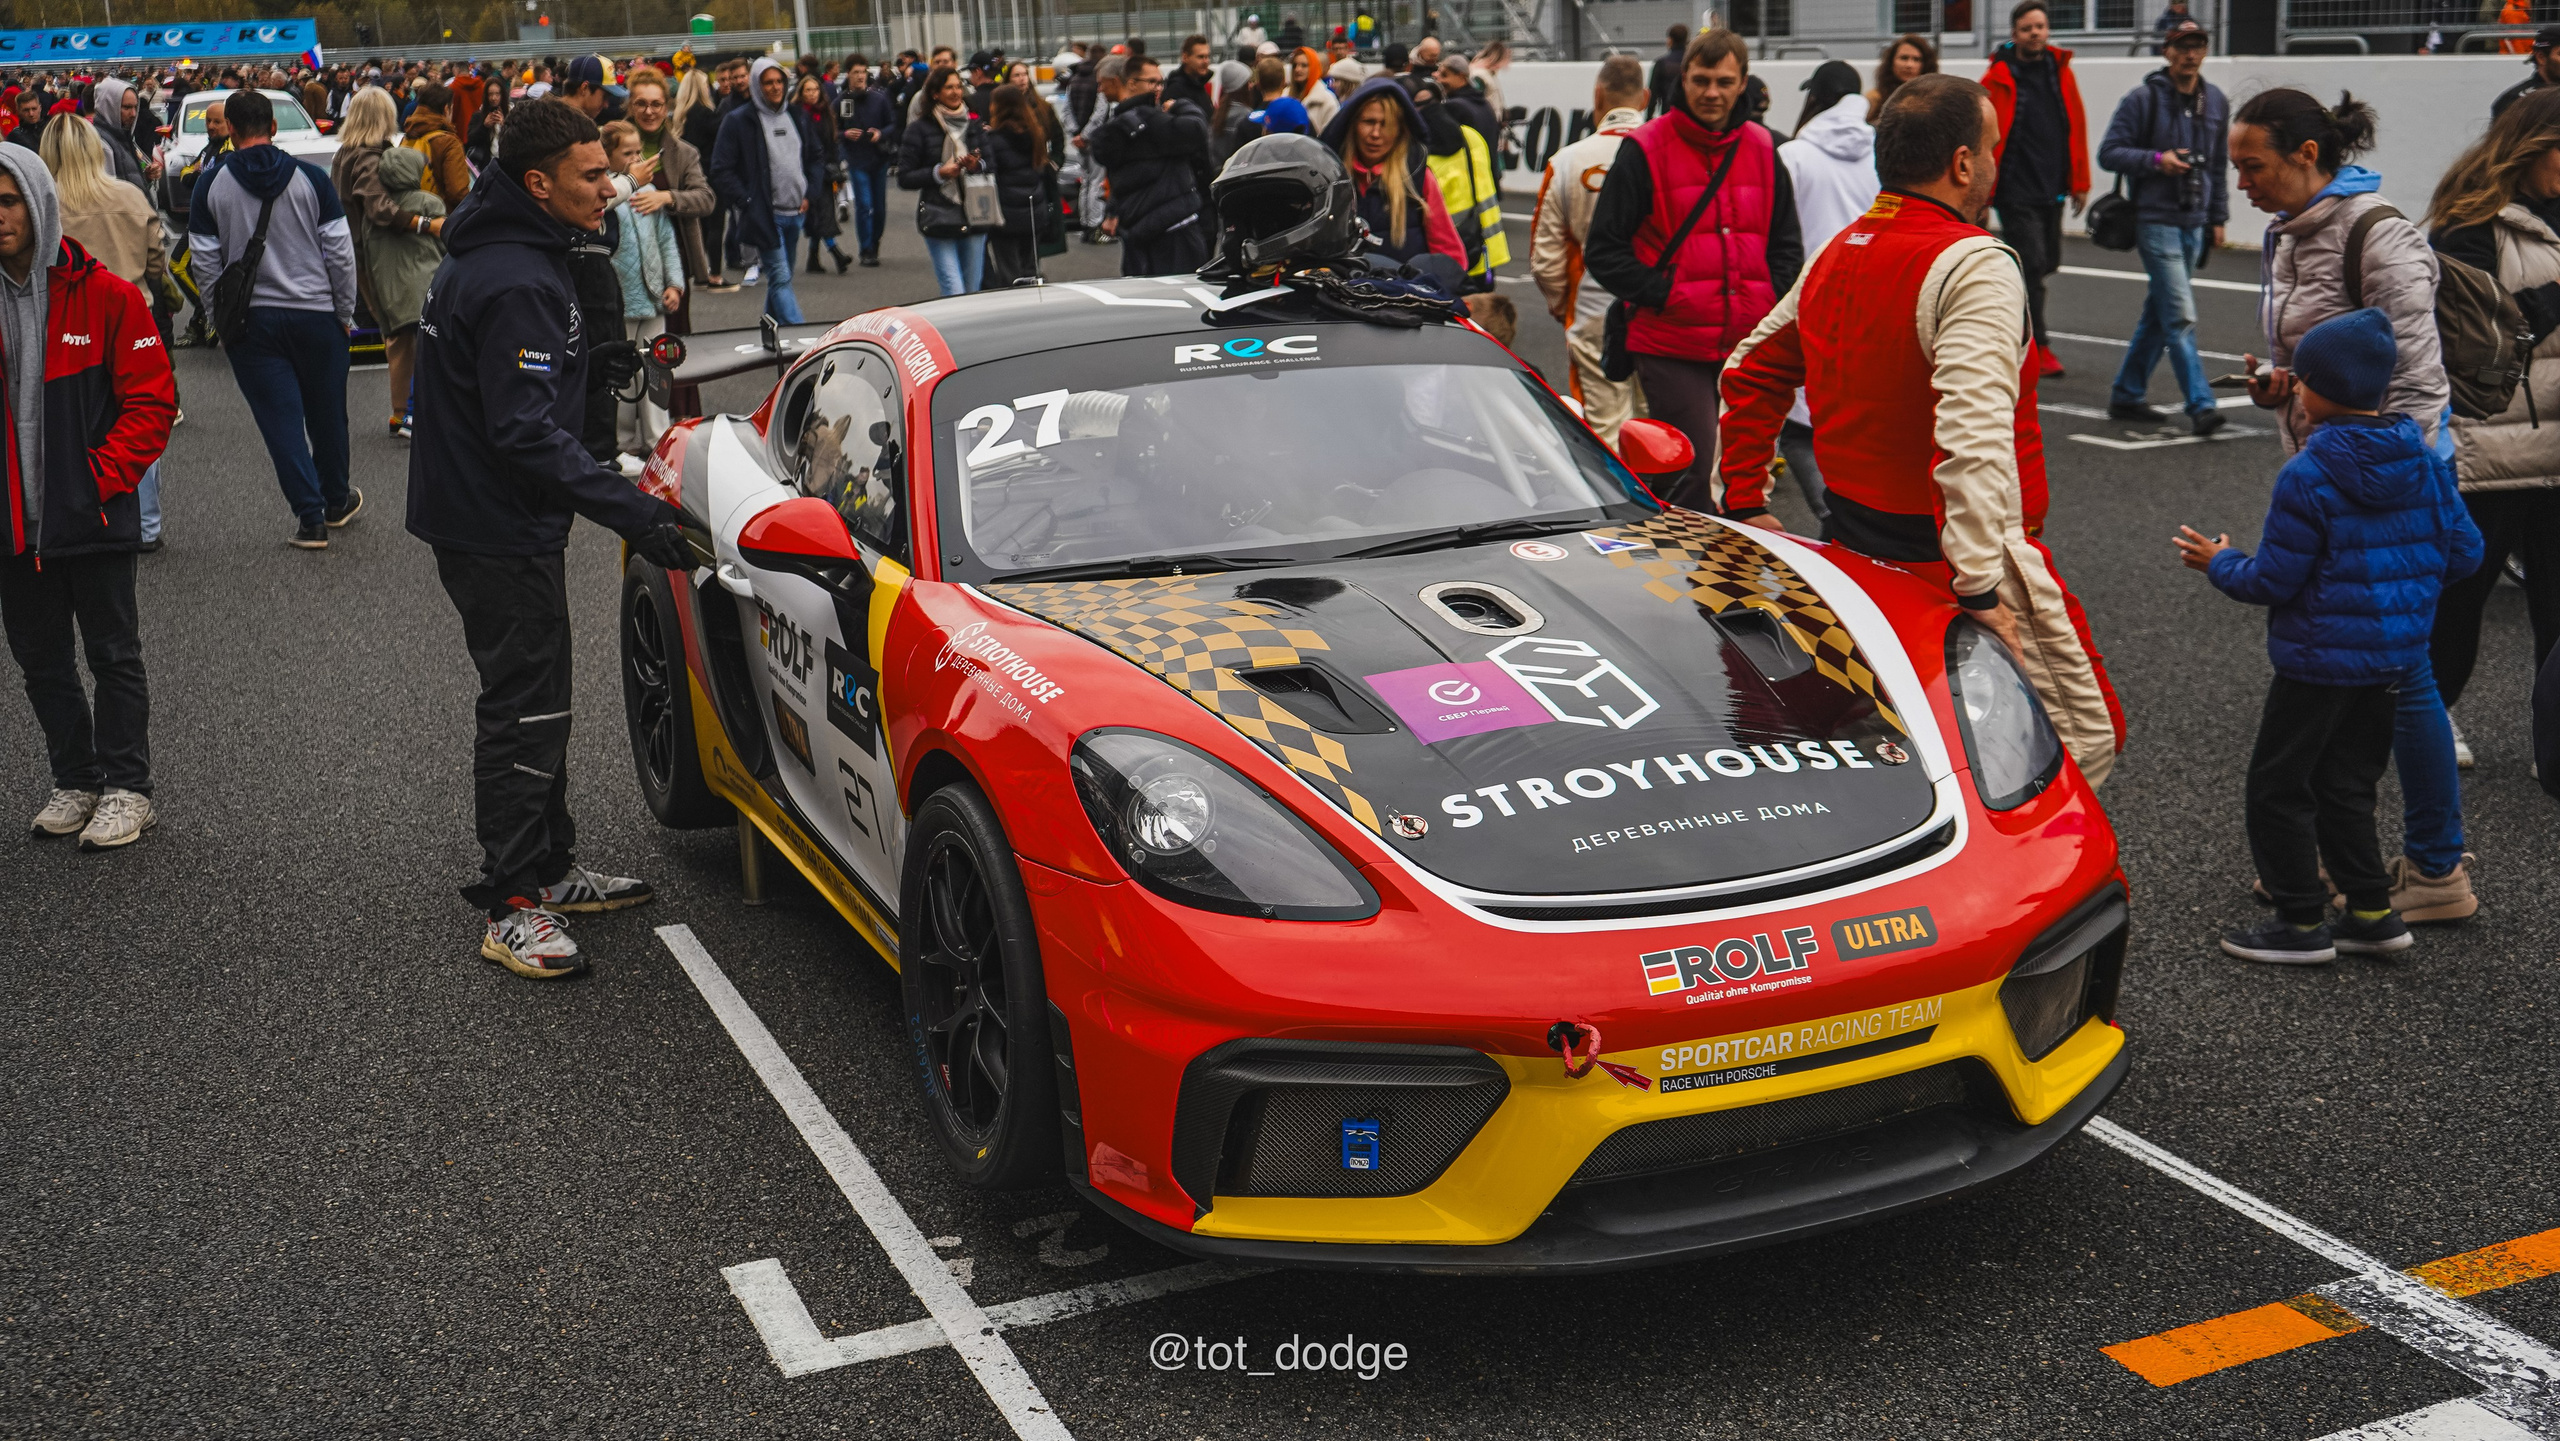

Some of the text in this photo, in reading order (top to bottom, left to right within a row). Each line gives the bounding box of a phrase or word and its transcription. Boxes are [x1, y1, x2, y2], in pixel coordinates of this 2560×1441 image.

[62, 333, 91, 346] MOTUL
[519, 348, 551, 361] Ansys
[1180, 364, 1218, 373] RUSSIAN
[1220, 359, 1271, 368] ENDURANCE
[958, 388, 1070, 468] 27
[764, 601, 814, 688] ROLF
[969, 635, 1064, 704] STROYHOUSE
[950, 655, 1032, 723] ДЕРЕВЯННЫЕ ДОМА
[1439, 705, 1510, 721] СБЕР Первый
[838, 757, 886, 855] 27
[1441, 739, 1874, 828] STROYHOUSE
[1573, 801, 1831, 853] ДЕРЕВЯННЫЕ ДОМА
[1674, 925, 1819, 989] ROLF
[1843, 914, 1928, 950] ULTRA
[1686, 975, 1812, 1005] Qualität ohne Kompromisse
[1660, 997, 1943, 1071] SPORTCAR RACING TEAM
[1662, 1077, 1691, 1092] RACE
[1694, 1072, 1724, 1087] WITH
[1726, 1064, 1776, 1083] PORSCHE
